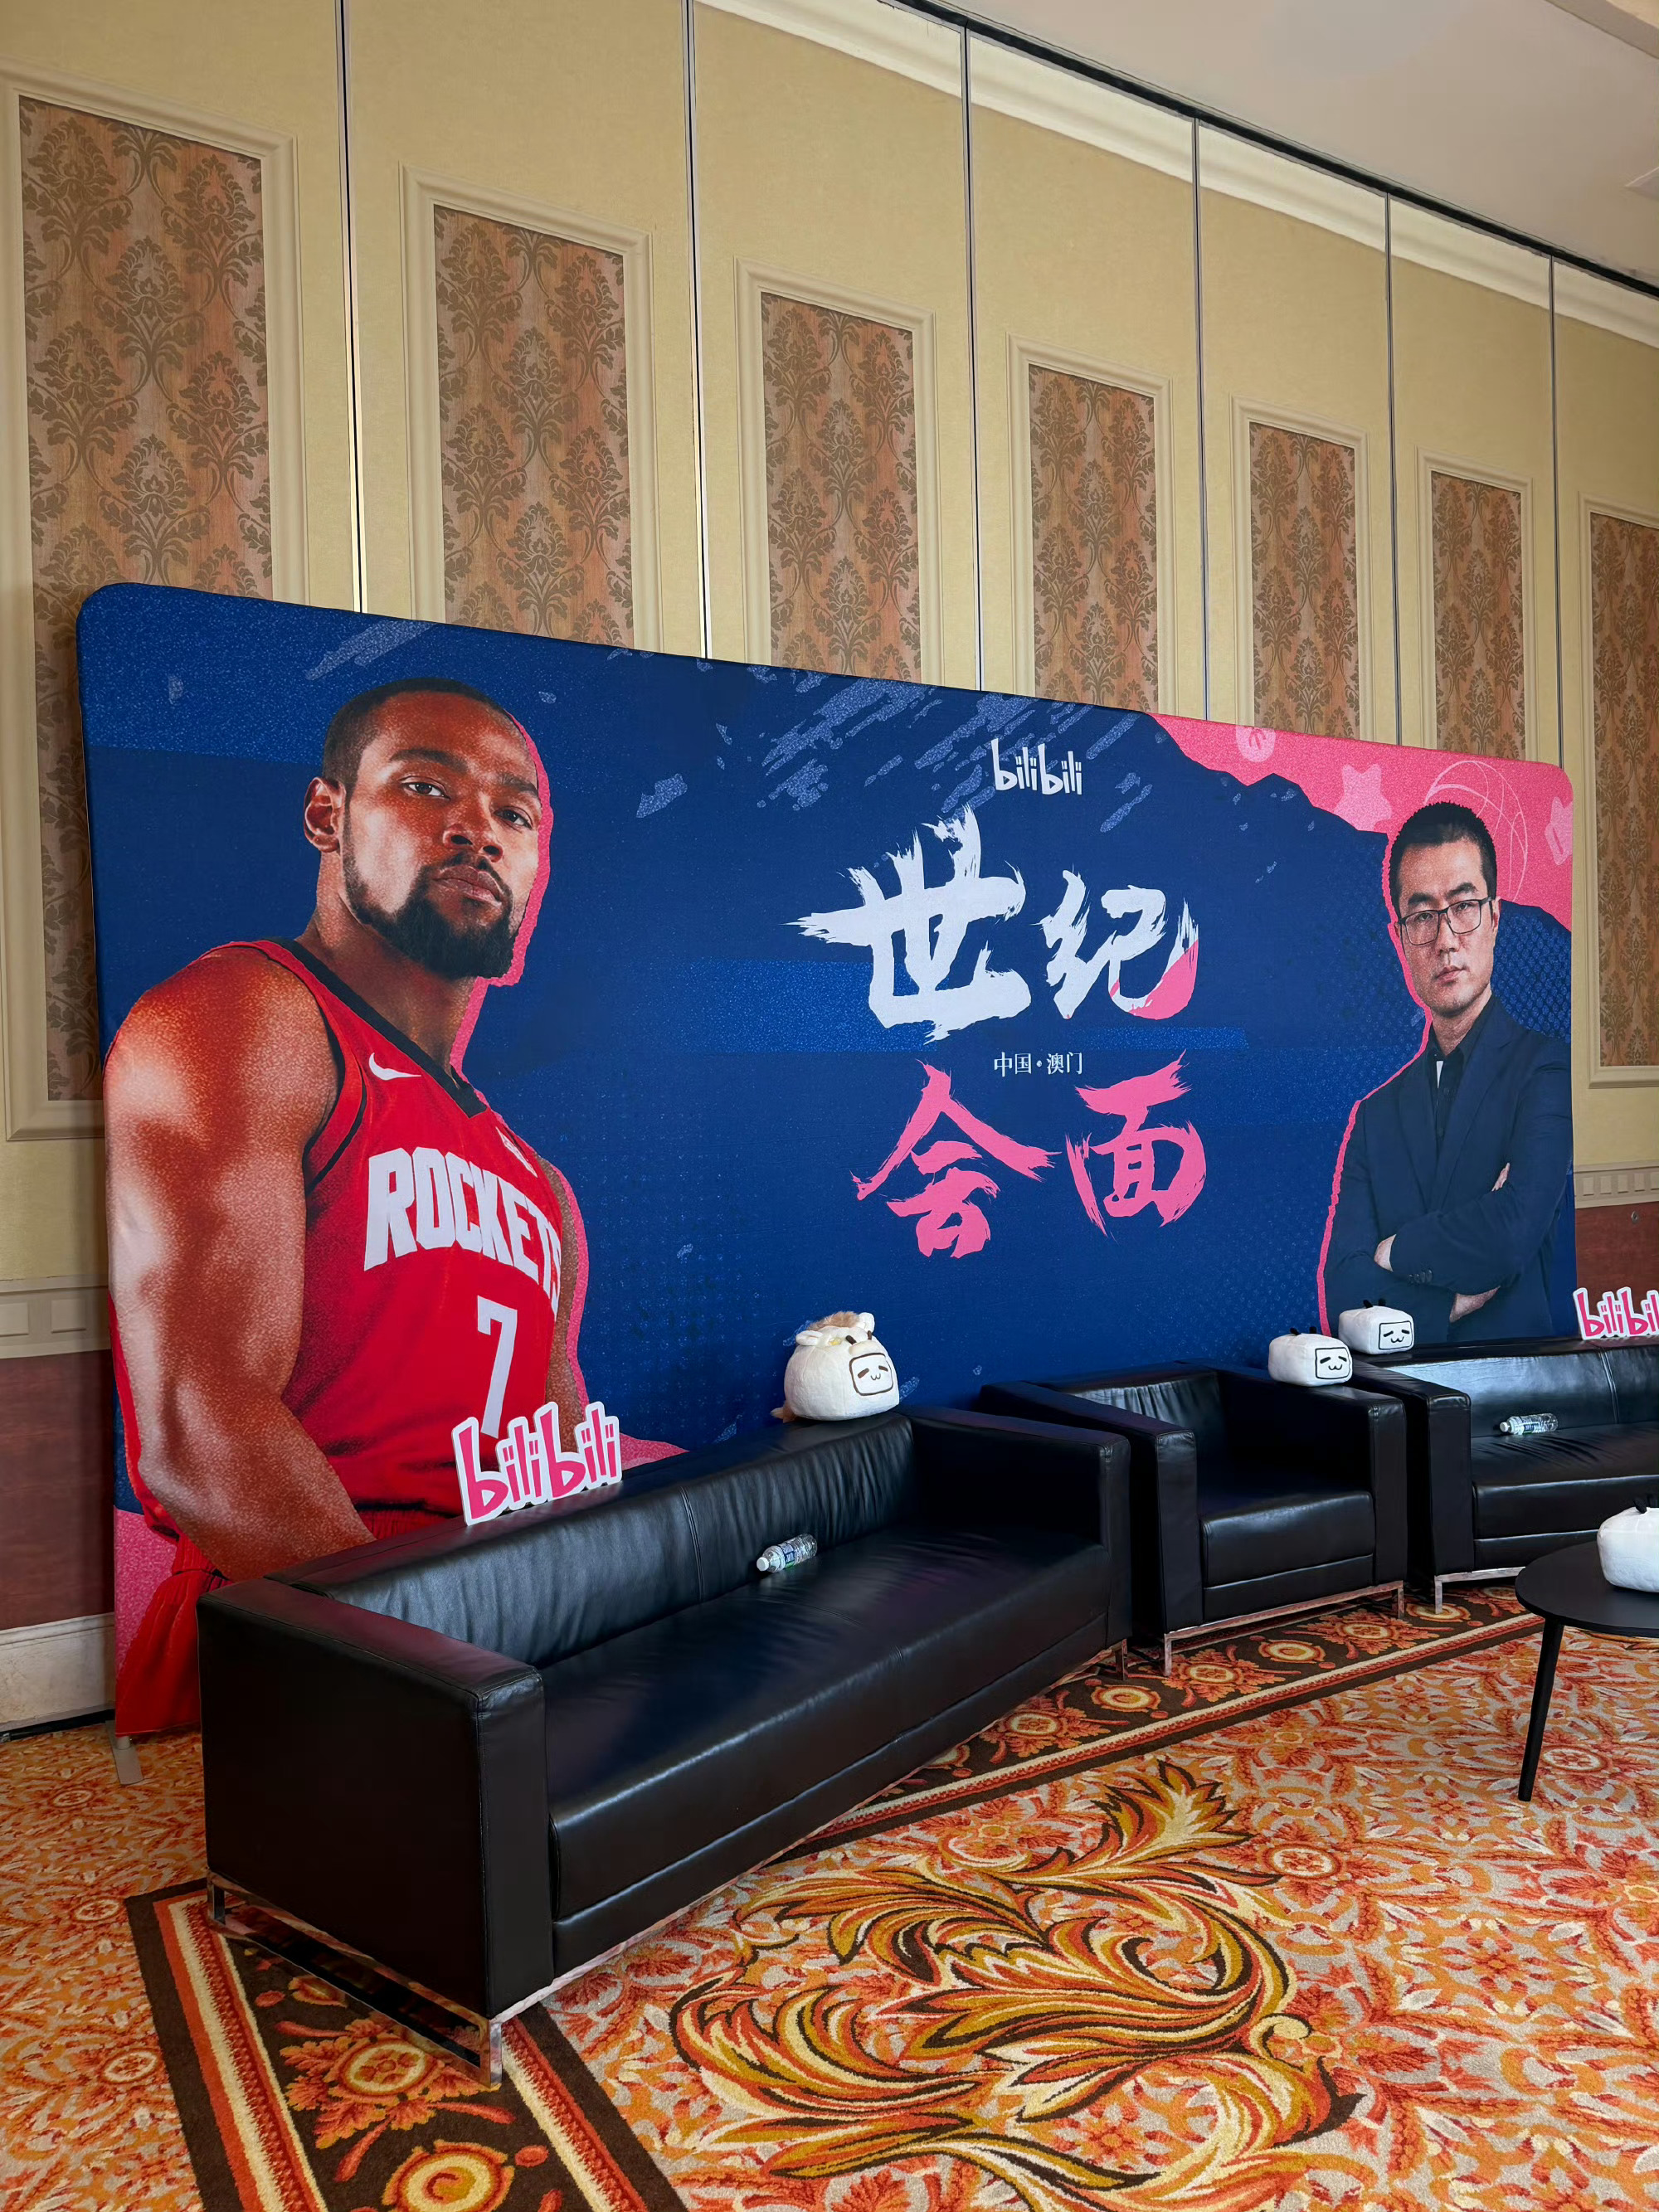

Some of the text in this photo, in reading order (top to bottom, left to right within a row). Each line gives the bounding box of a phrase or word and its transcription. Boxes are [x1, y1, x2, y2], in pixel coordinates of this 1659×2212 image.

[990, 737, 1082, 795] bilibili
[781, 803, 1200, 1045] 世纪
[994, 1051, 1083, 1077] 中国·澳门
[849, 1049, 1207, 1259] 会面
[477, 1295, 518, 1439] 7
[1575, 1289, 1659, 1338] bilibil
[456, 1407, 618, 1521] bilibili
